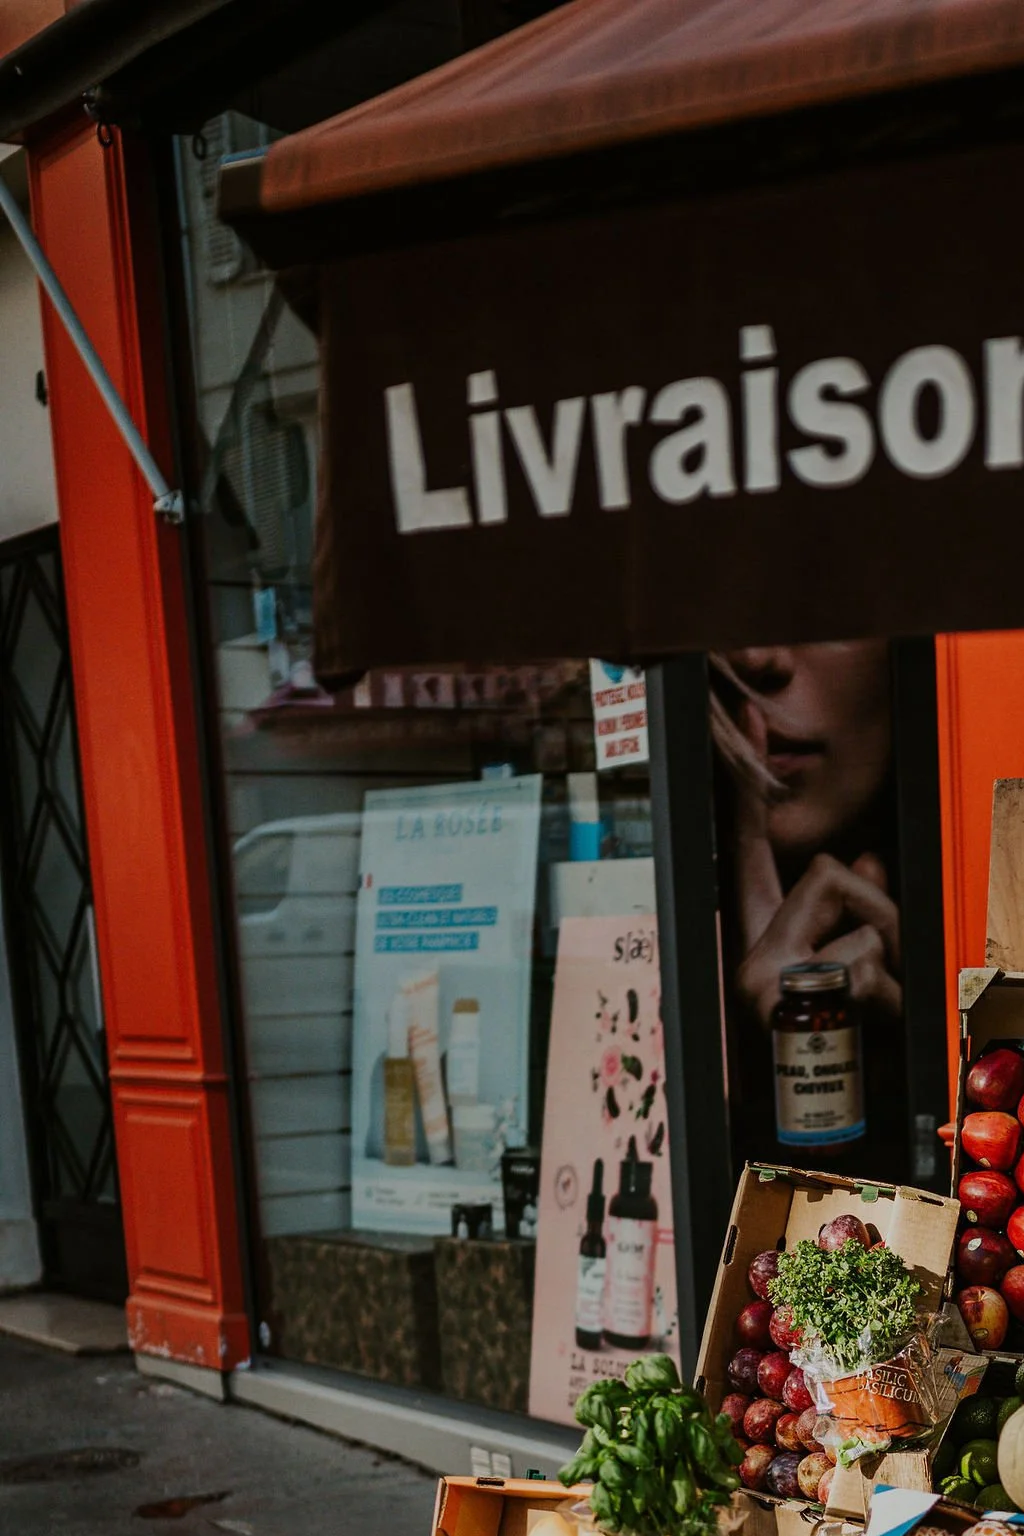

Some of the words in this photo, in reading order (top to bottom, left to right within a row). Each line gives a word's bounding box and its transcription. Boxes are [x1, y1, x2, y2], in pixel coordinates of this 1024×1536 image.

[396, 814, 425, 840] LA
[593, 1358, 627, 1379] SOLU
[856, 1367, 908, 1387] BASILIC
[857, 1379, 921, 1404] BASILICUM
